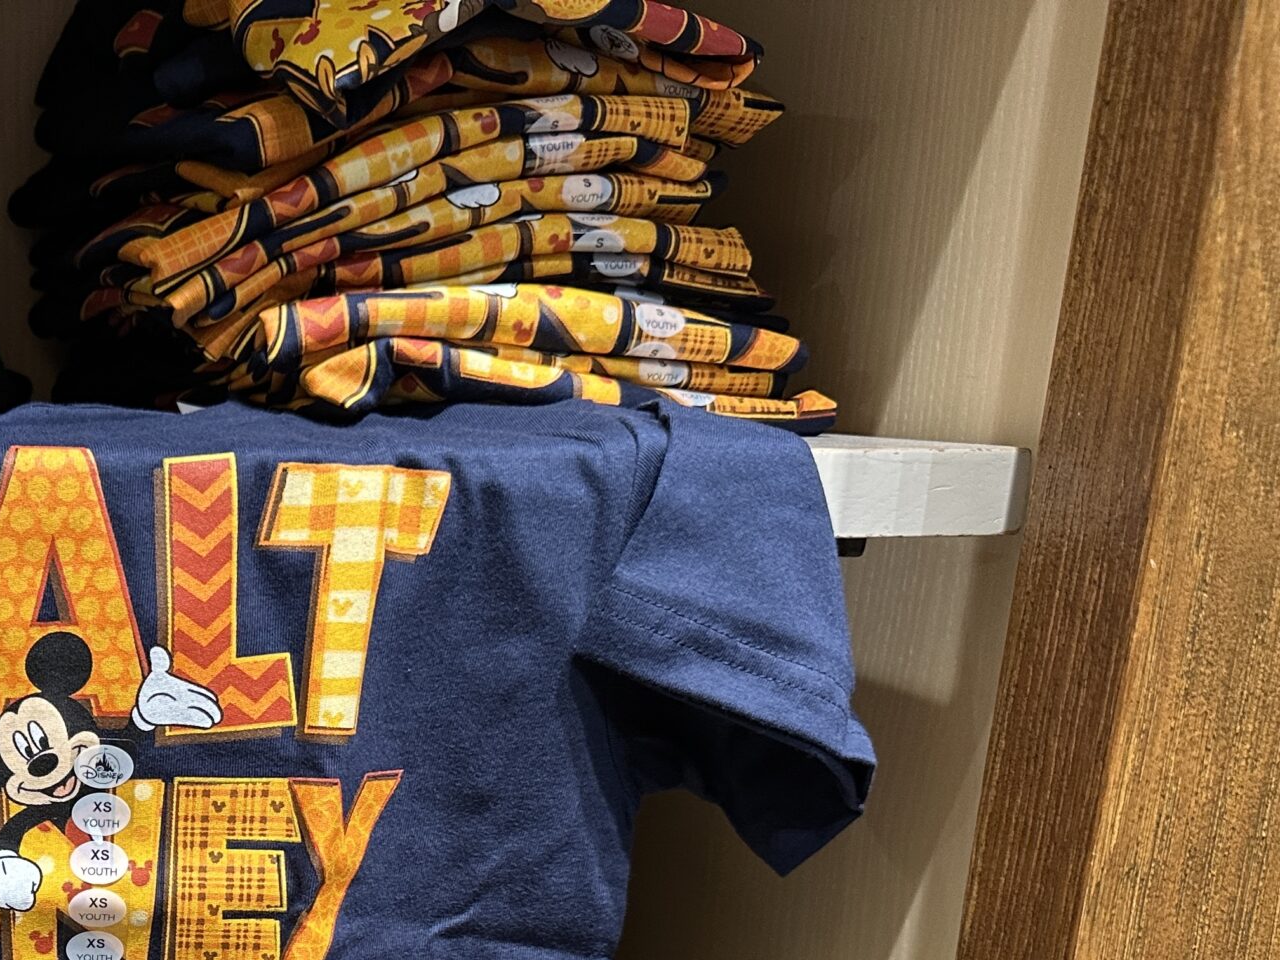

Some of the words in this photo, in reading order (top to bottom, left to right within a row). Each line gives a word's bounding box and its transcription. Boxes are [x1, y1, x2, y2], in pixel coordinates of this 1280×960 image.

[662, 84, 693, 99] YOUTH
[550, 120, 560, 130] S
[539, 140, 574, 152] YOUTH
[582, 178, 592, 188] S
[570, 191, 604, 203] YOUTH
[595, 238, 604, 248] S
[603, 259, 638, 270] YOUTH
[645, 318, 678, 331] YOUTH
[646, 372, 680, 383] YOUTH
[92, 801, 112, 813] XS
[82, 818, 119, 829] YOUTH
[90, 849, 110, 861] XS
[81, 866, 117, 877] YOUTH
[89, 897, 108, 908] XS
[78, 912, 116, 922] YOUTH
[86, 938, 105, 949] XS
